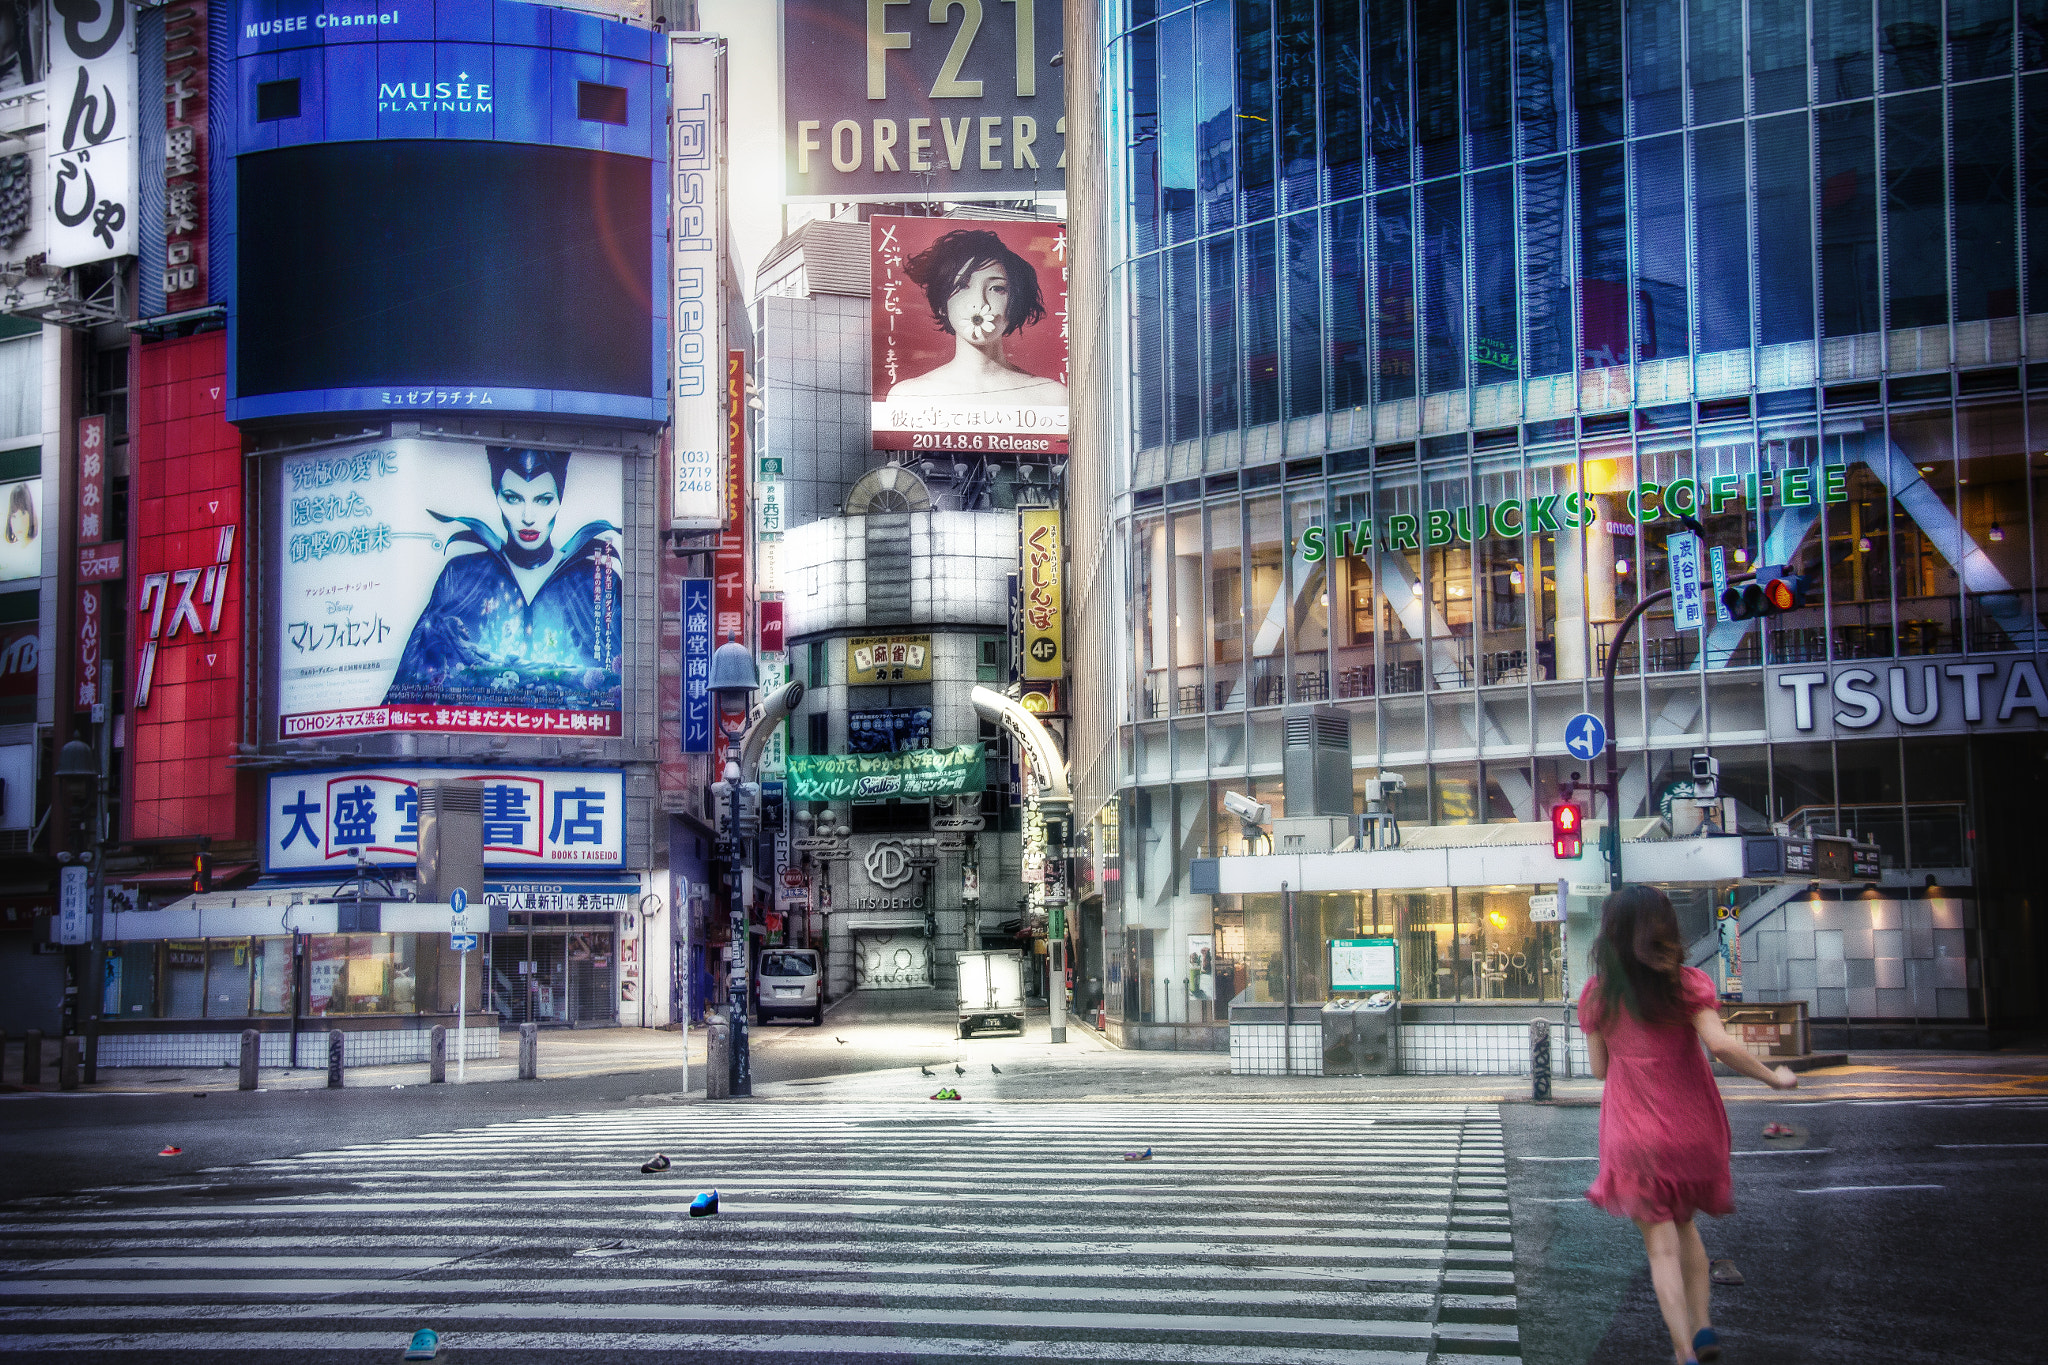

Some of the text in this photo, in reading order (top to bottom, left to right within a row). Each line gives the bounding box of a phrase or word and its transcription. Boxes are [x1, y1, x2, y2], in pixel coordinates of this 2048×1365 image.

[246, 10, 399, 38] MUSEE Channel
[867, 0, 1035, 99] F21
[379, 101, 492, 113] PLATINUM
[163, 8, 199, 293] 三千里薬品
[797, 115, 1040, 174] FOREVER
[678, 94, 712, 398] Taisei neon
[878, 224, 903, 384] メジャーデビューします
[381, 391, 494, 405] ミュゼプラチナム
[682, 451, 709, 464] (03)
[912, 434, 1049, 451] 2014.8.6 Release
[84, 424, 101, 537] お好み焼
[679, 467, 712, 479] 3719
[679, 480, 712, 493] 2468
[763, 485, 779, 529] 渋谷西村
[1302, 463, 1848, 563] STARBUCKS COFFEE
[1672, 555, 1682, 591] Shibuya
[1679, 540, 1699, 621] 渋谷駅前
[79, 590, 97, 705] もんじゃ焼
[288, 611, 391, 654] マレフィセント
[1032, 641, 1054, 658] 4F
[687, 591, 707, 741] 大盛堂商事ビル
[874, 645, 905, 663] 麻雀
[288, 711, 387, 733] TOHOシネマズ渋谷
[551, 850, 618, 861] BOOKS TAISEIDO
[65, 873, 77, 932] 文化村通り
[502, 884, 563, 893] TAISEIDO
